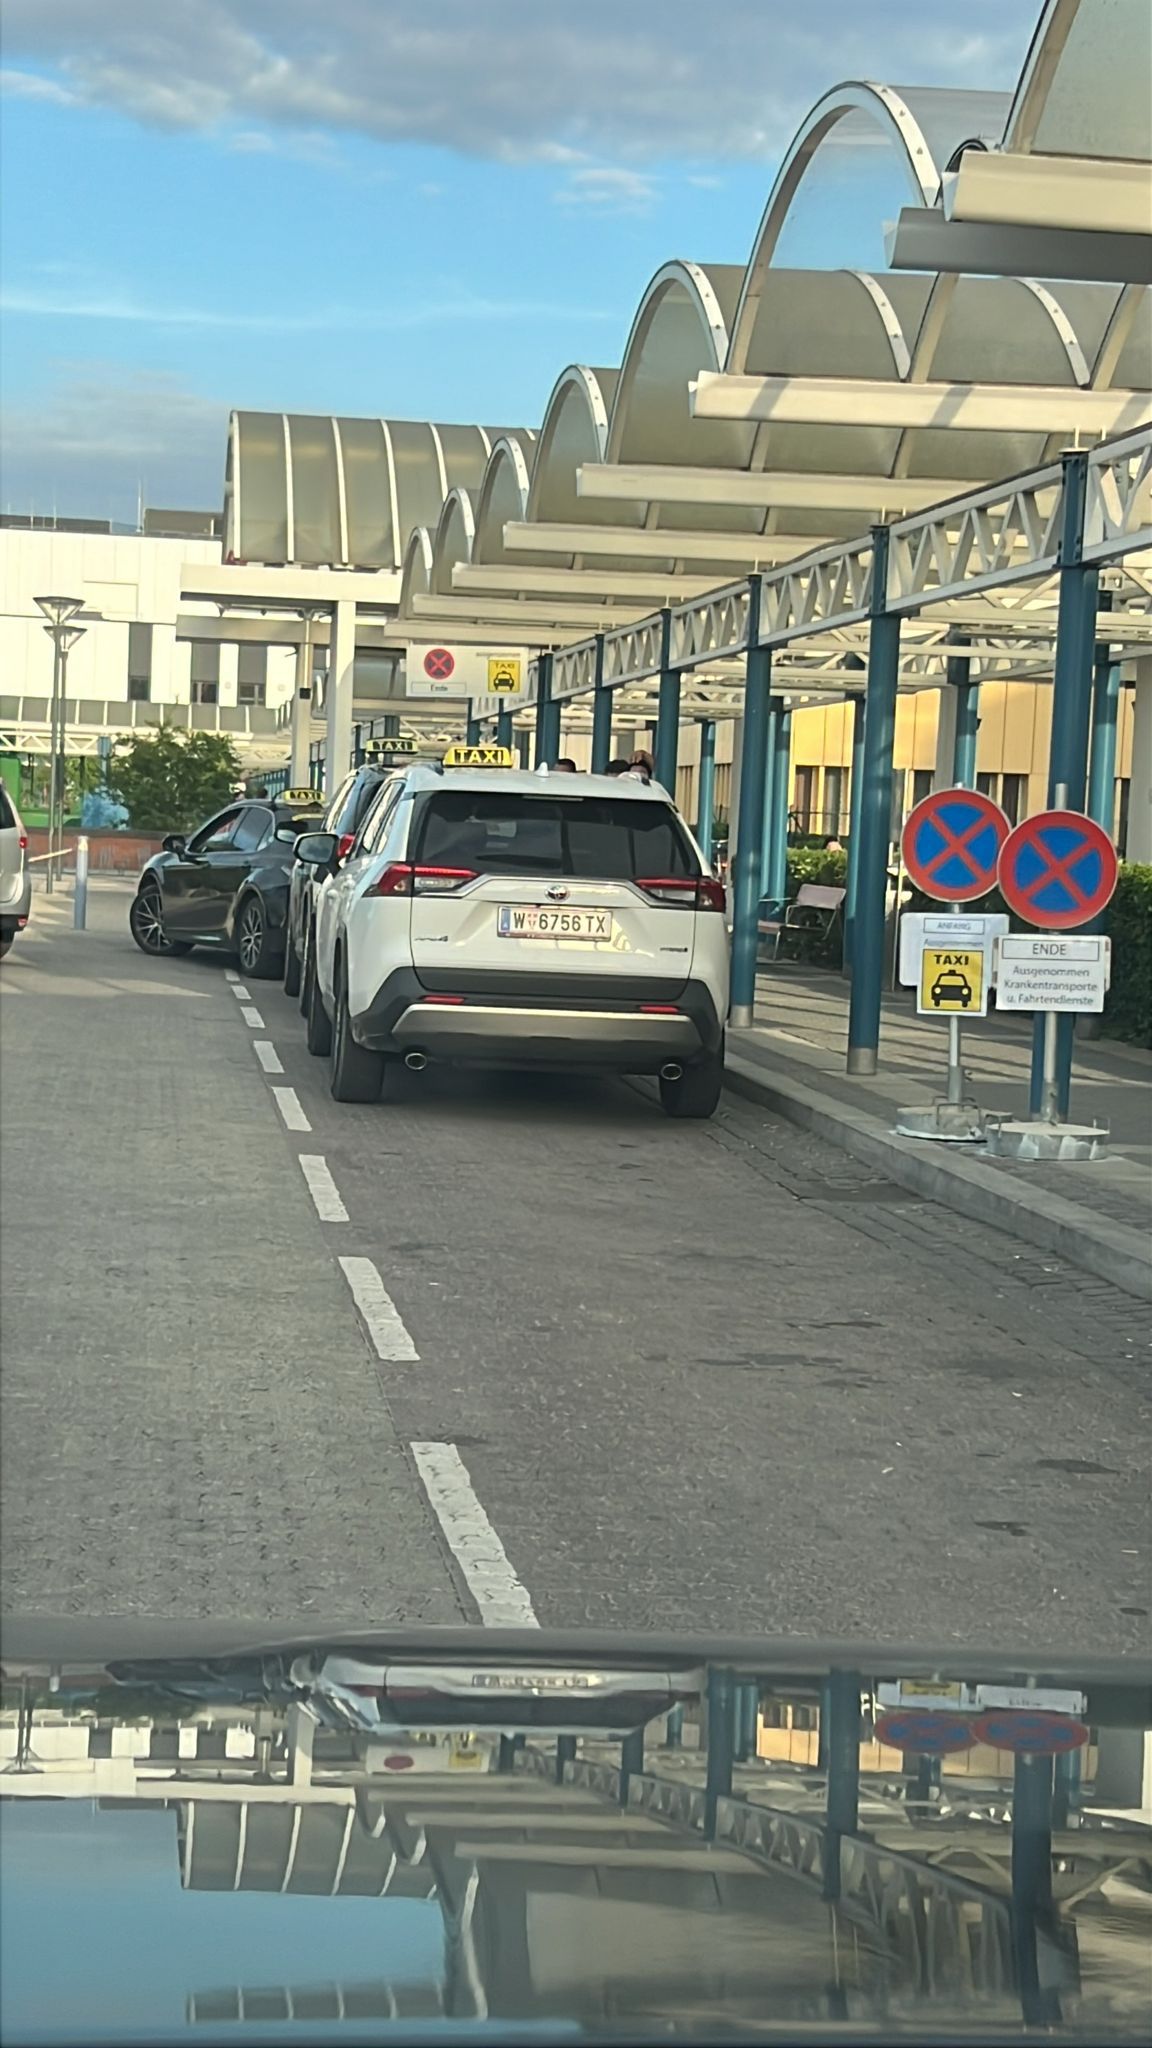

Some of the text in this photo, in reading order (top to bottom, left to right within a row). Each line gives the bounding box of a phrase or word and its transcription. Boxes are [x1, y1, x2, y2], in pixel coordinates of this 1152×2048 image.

[376, 740, 410, 751] TAXI
[456, 748, 503, 764] TAXI
[292, 791, 321, 801] TAXI
[513, 911, 606, 934] W 6756 TX
[1032, 943, 1068, 956] ENDE
[933, 954, 970, 966] TAXI
[1013, 966, 1090, 978] Ausgenommen
[1004, 980, 1098, 992] Krankentransporte
[1018, 994, 1094, 1006] Fahrtendienste
